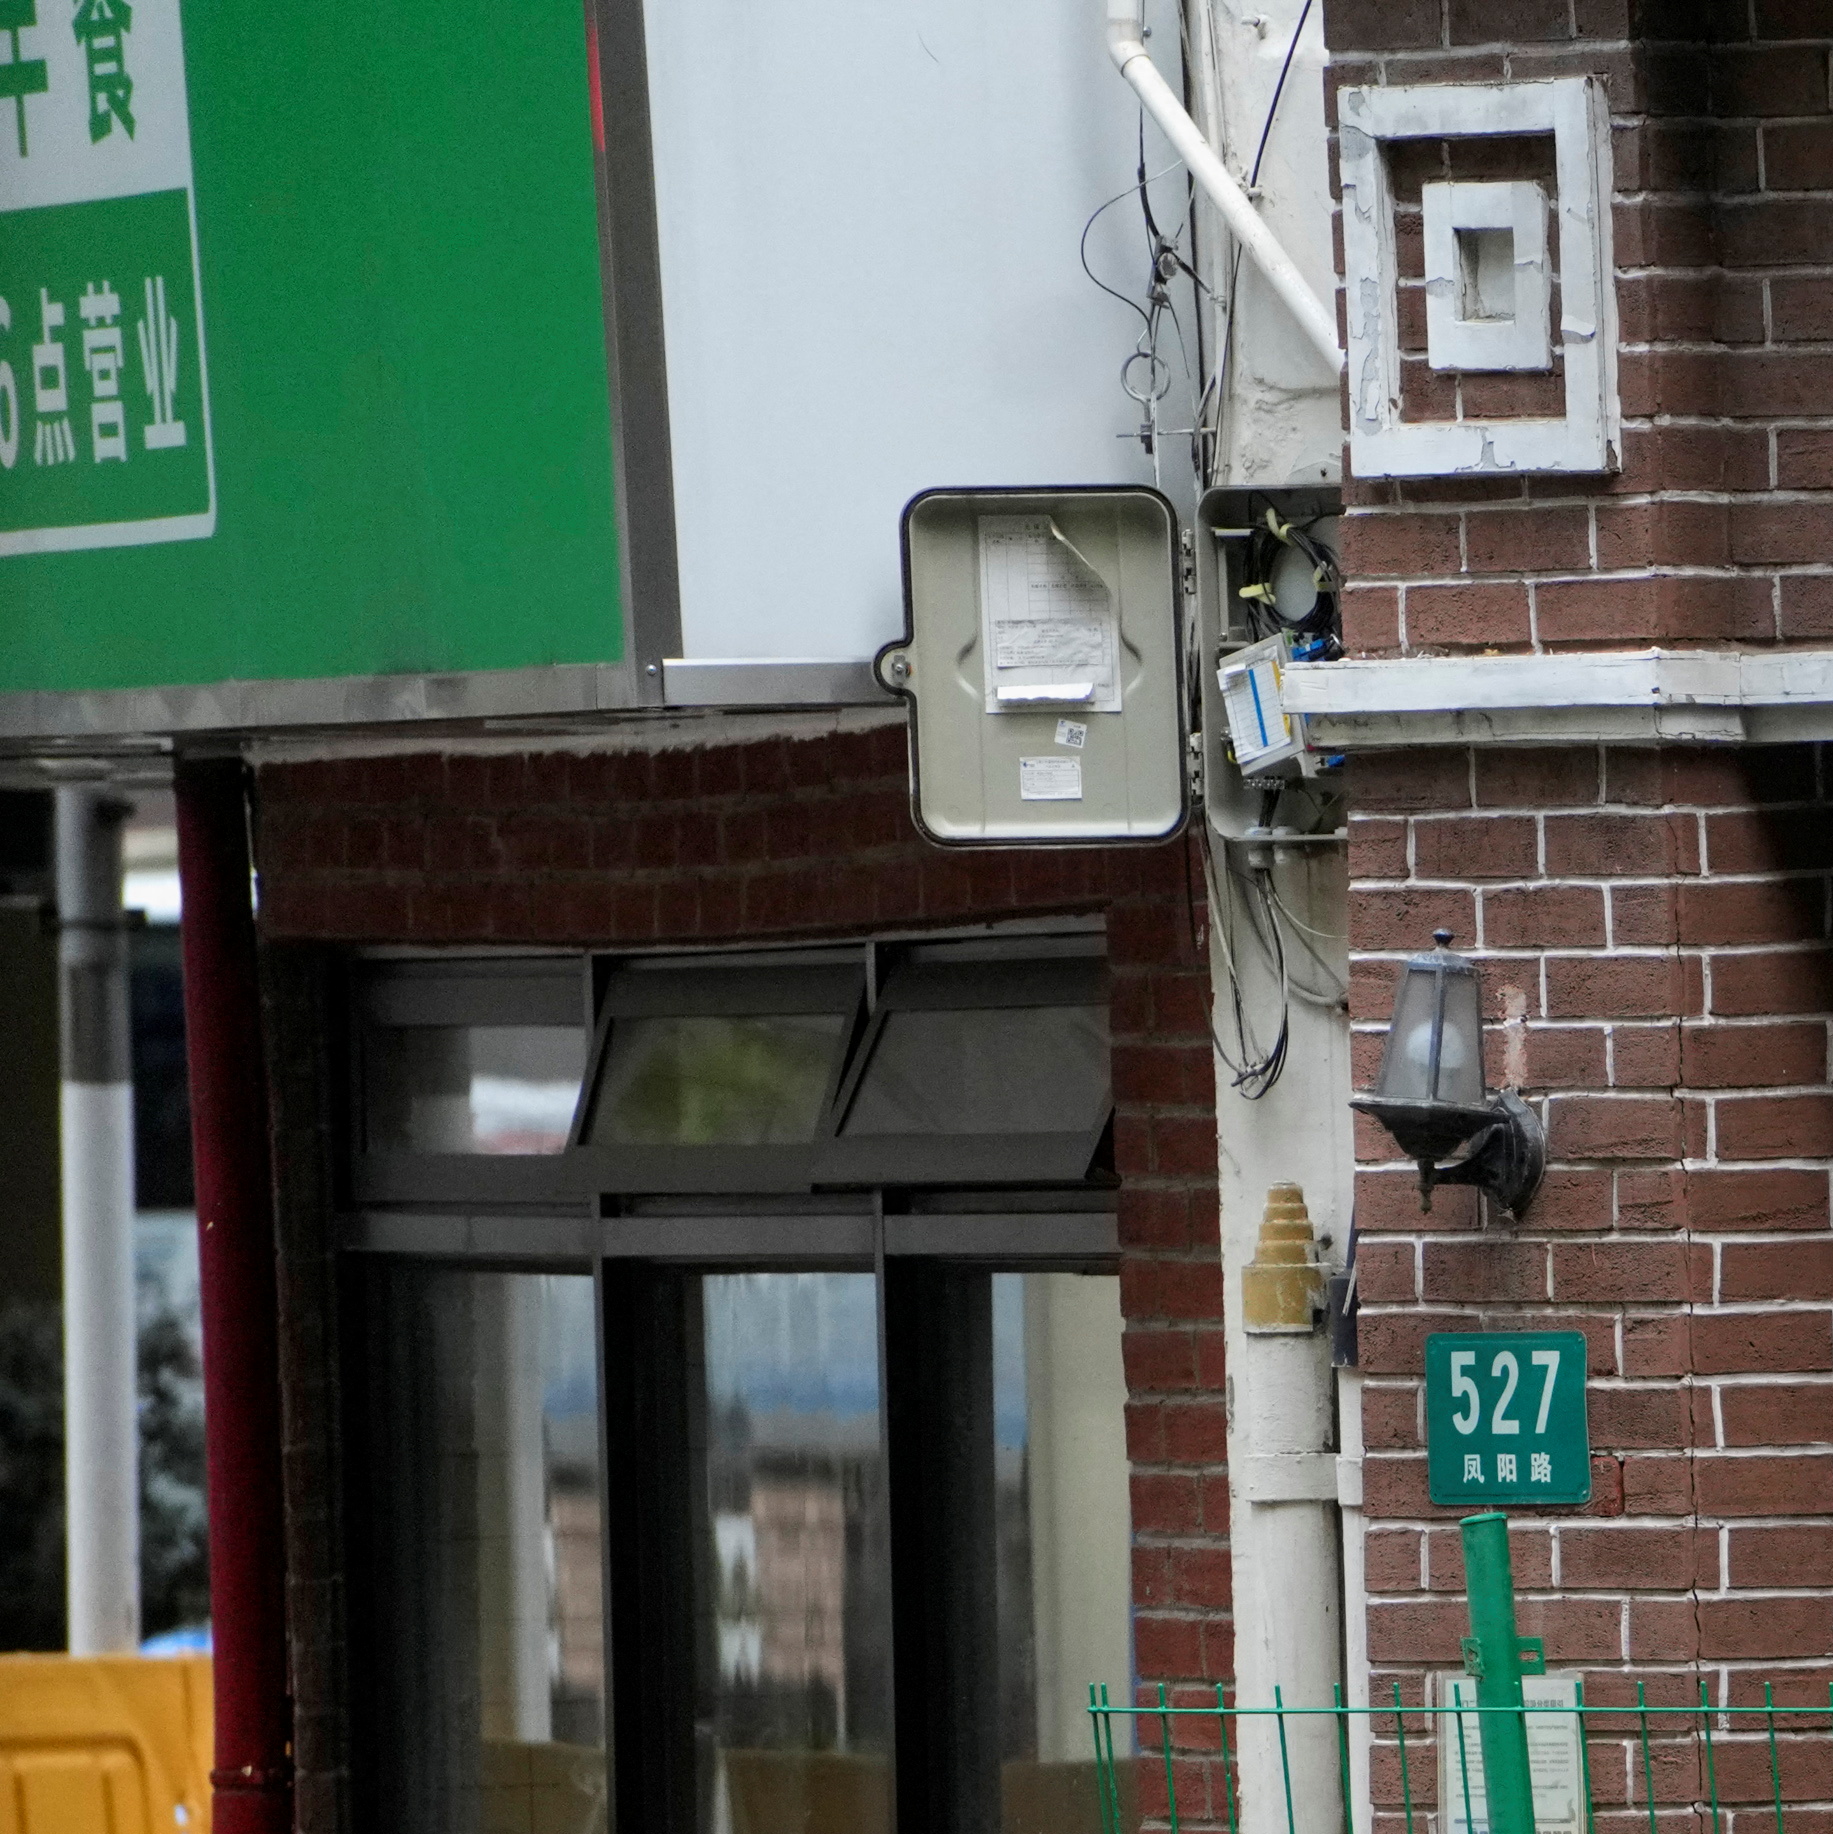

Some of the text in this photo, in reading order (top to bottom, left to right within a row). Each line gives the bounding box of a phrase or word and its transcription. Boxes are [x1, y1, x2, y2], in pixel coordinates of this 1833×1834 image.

[1450, 1350, 1561, 1436] 527
[1462, 1452, 1553, 1485] 凤阳路
